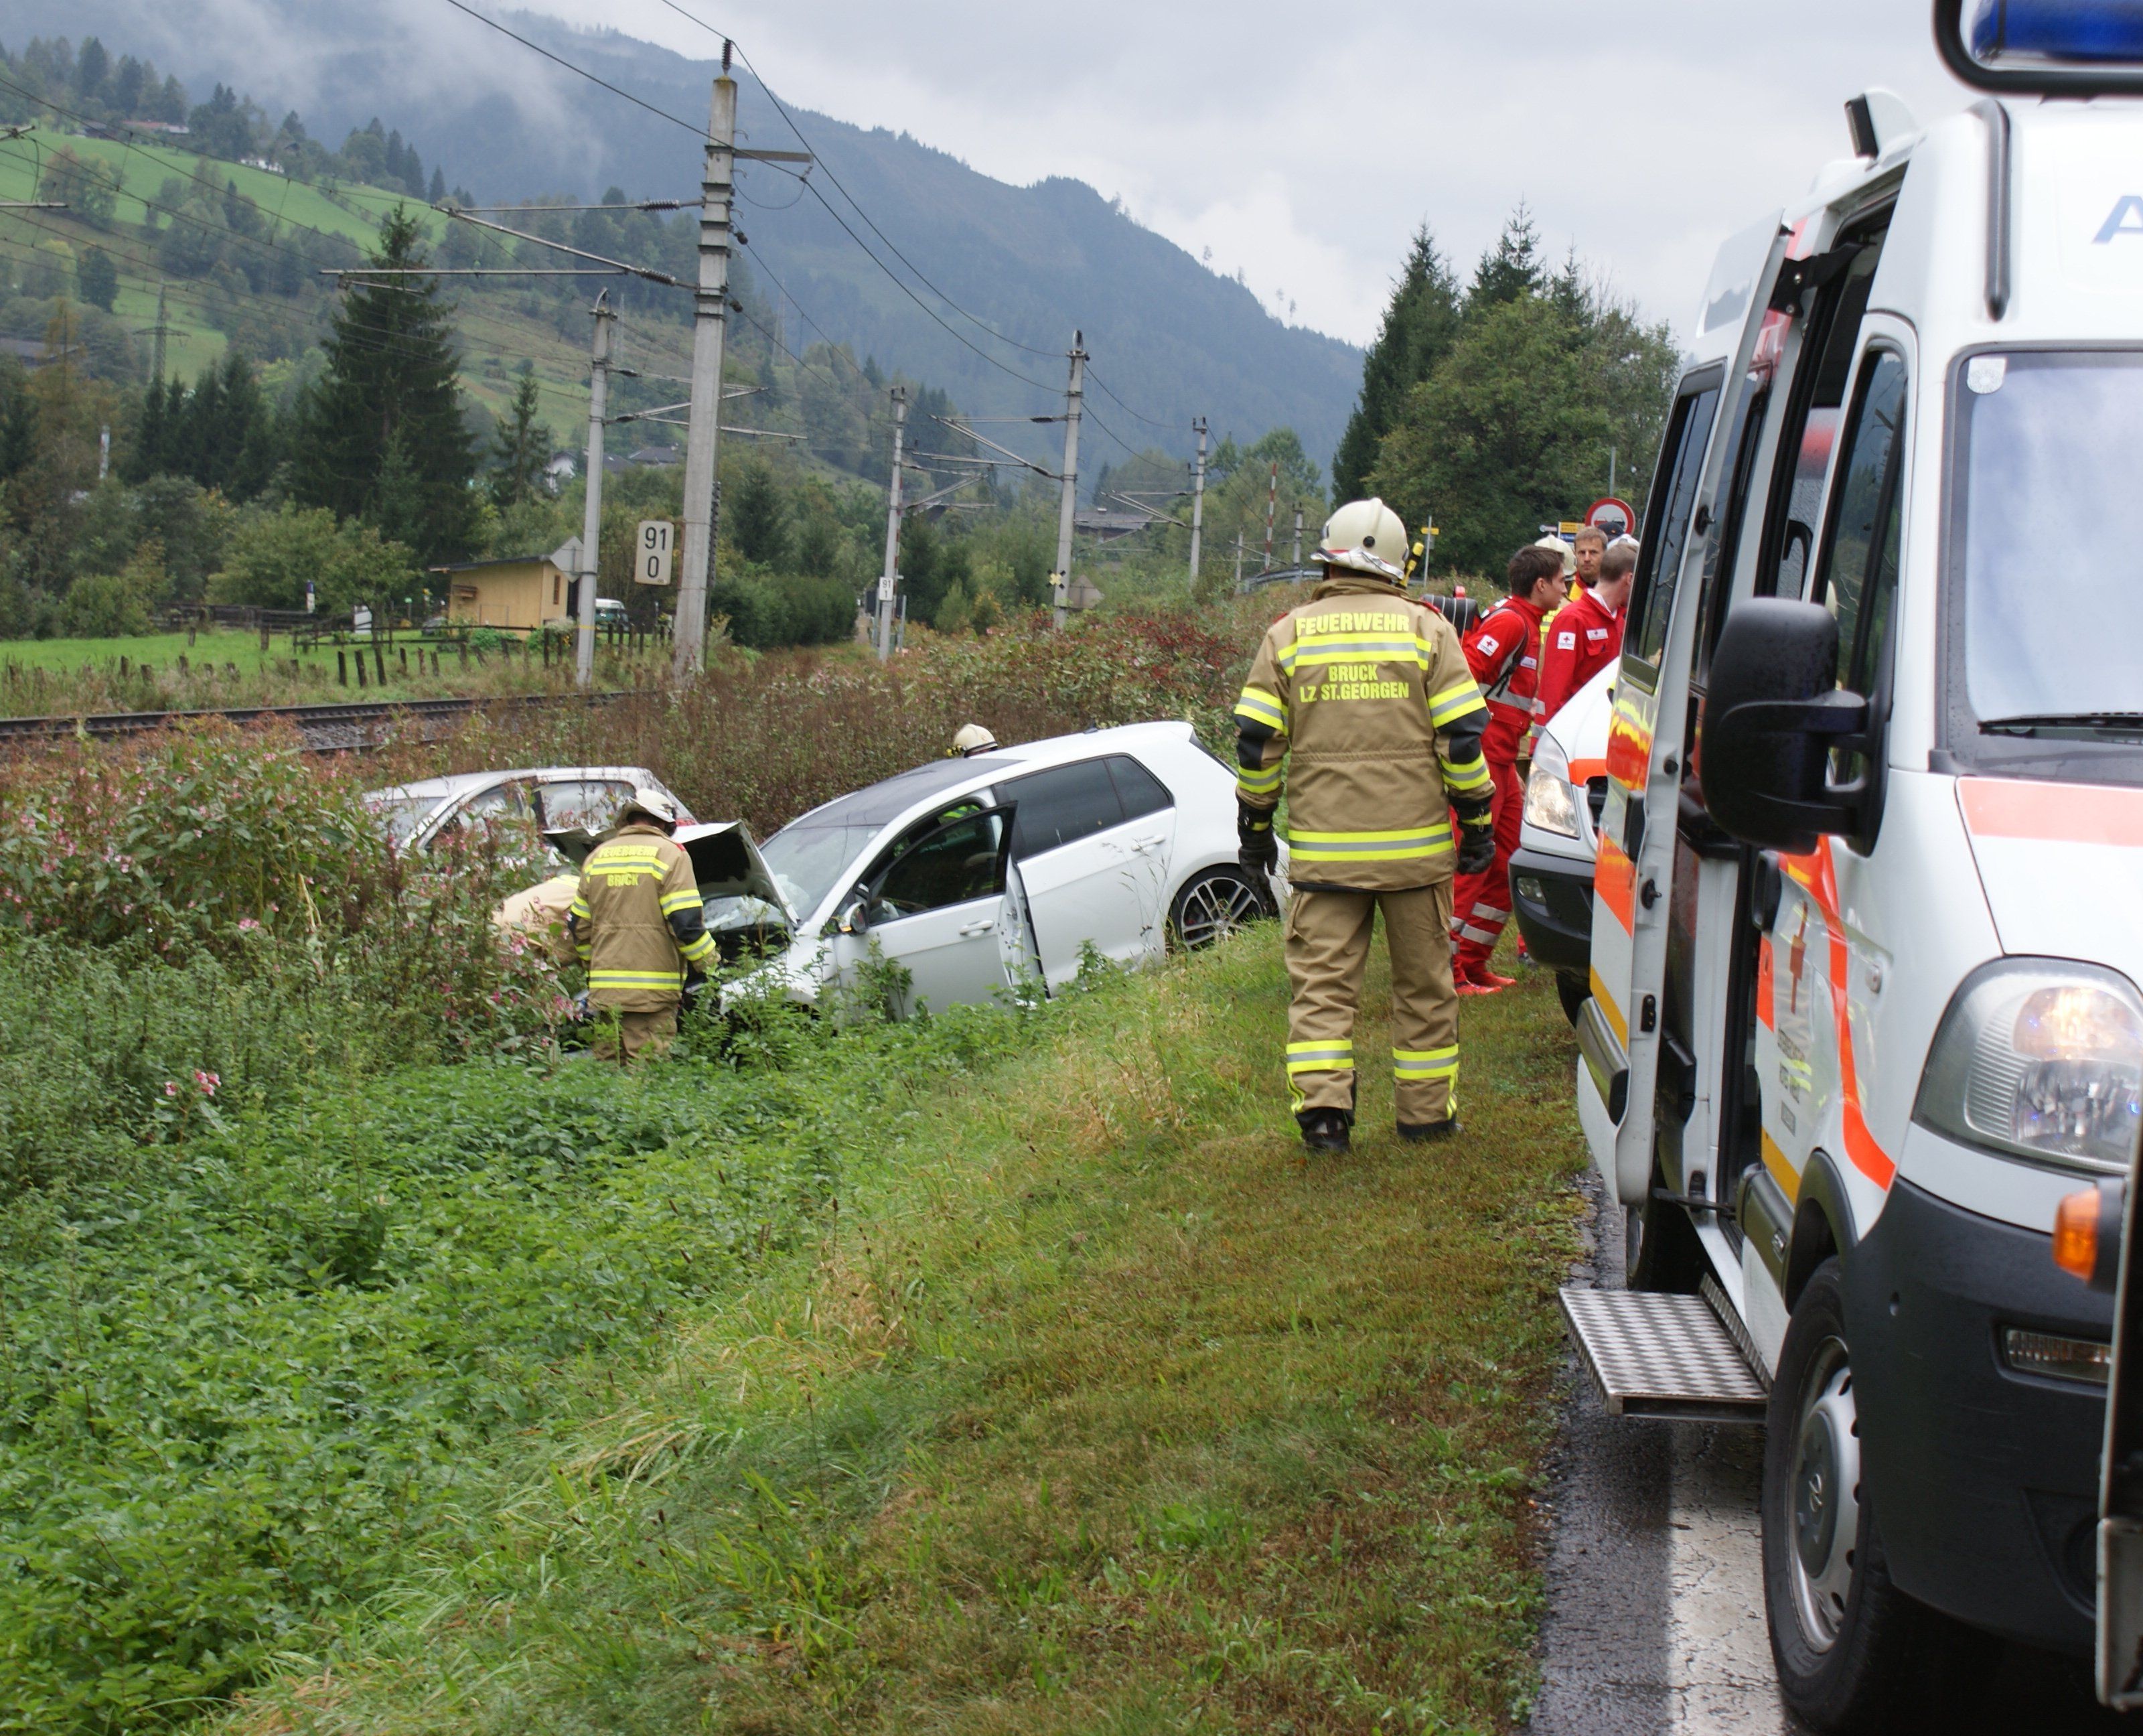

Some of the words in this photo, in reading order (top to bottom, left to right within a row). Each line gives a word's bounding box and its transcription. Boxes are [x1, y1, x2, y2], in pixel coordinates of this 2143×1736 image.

[645, 526, 667, 551] 91
[648, 556, 659, 578] 0
[883, 579, 891, 588] 91
[1296, 613, 1409, 636] FEUERWEHR
[1329, 664, 1378, 682] BRUCK
[1300, 686, 1317, 703] LZ
[1321, 682, 1409, 701] ST.GEORGEN
[599, 845, 659, 858] FEUERWEHR
[607, 873, 638, 887] BRUCK
